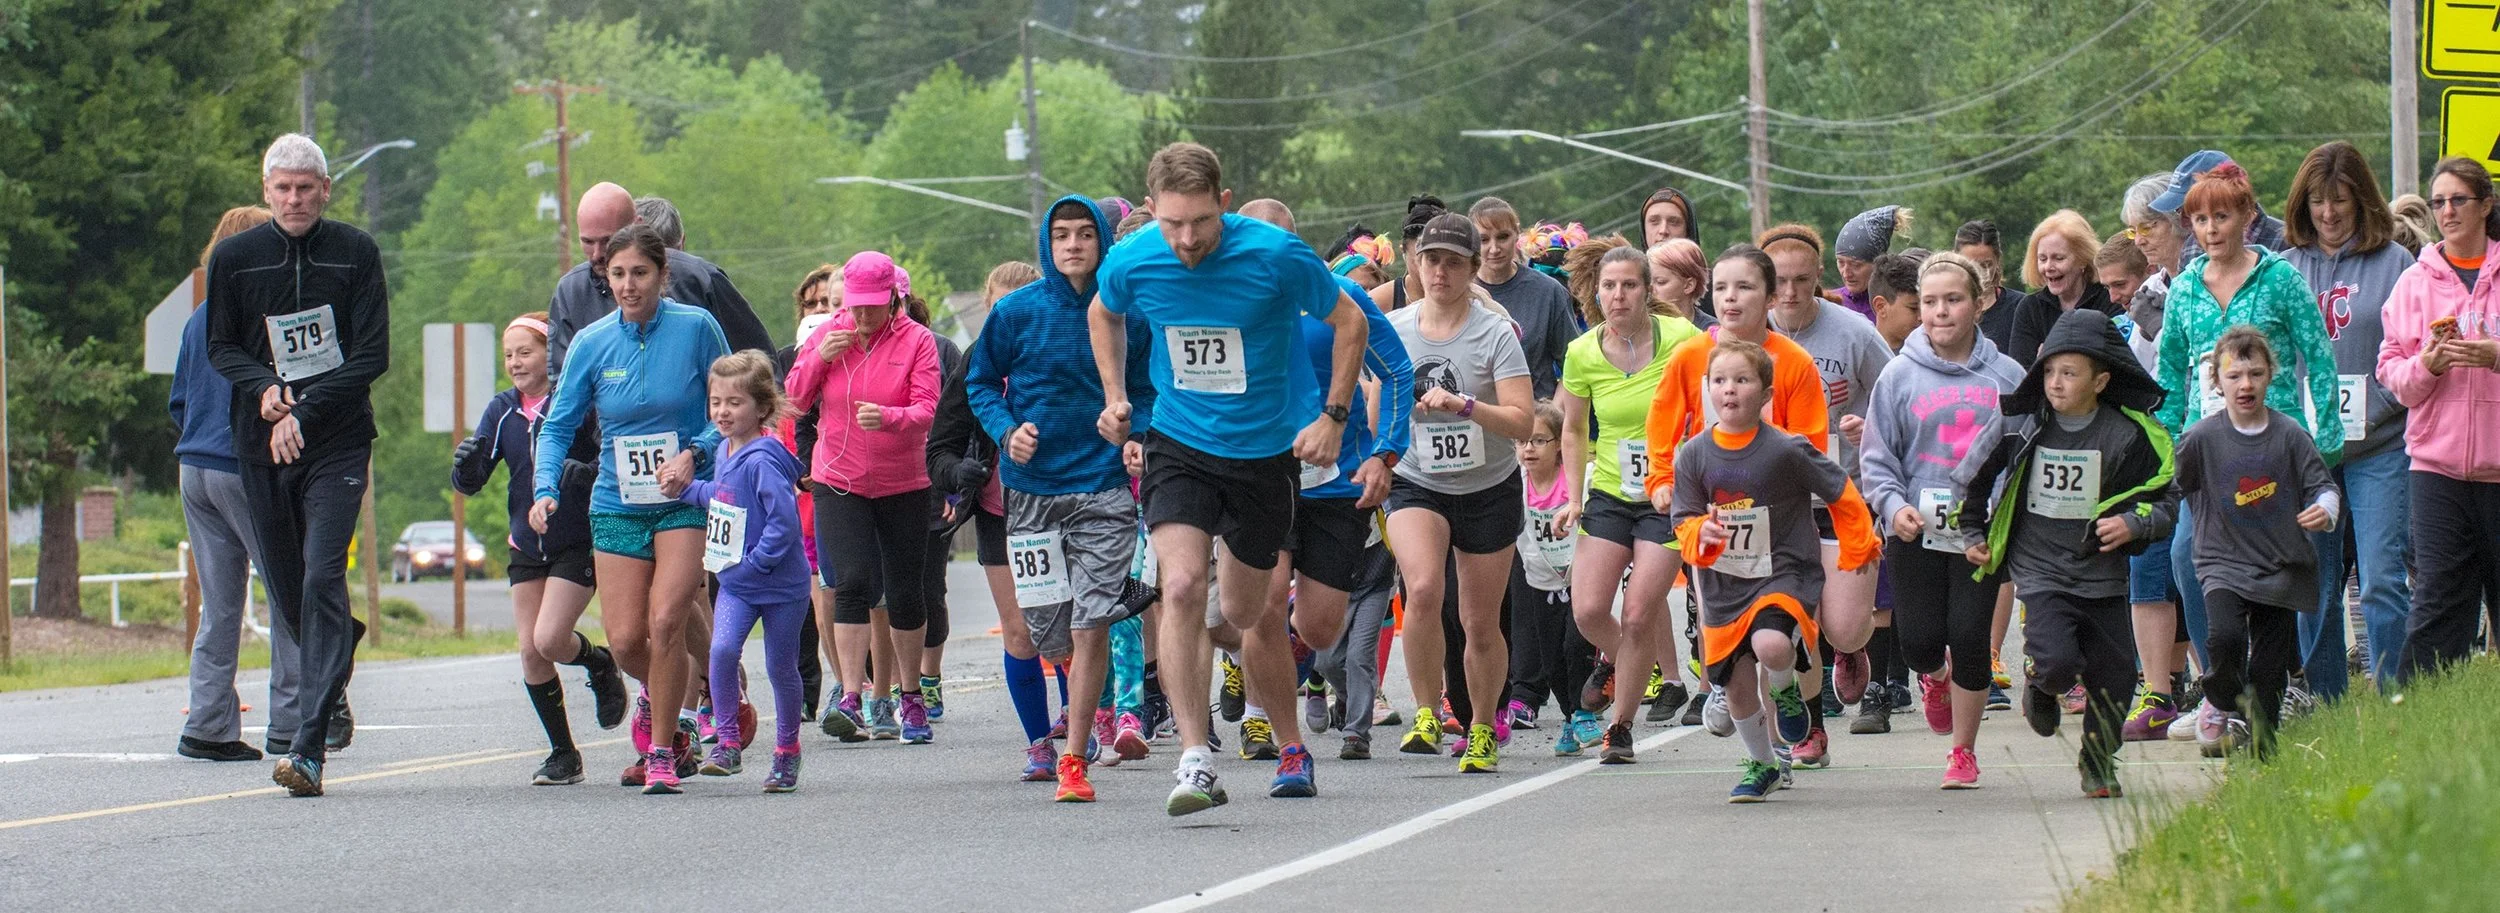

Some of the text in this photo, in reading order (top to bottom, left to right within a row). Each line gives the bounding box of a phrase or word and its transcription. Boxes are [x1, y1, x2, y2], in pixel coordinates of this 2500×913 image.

[277, 313, 321, 327] Team Nanno
[283, 322, 323, 353] 579
[1184, 338, 1226, 366] 573
[1447, 424, 1471, 432] Nanno
[623, 438, 667, 448] Team Nanno
[1432, 433, 1470, 461] 582
[628, 449, 665, 476] 516
[2040, 451, 2088, 462] Team Nanno
[2043, 463, 2083, 491] 532
[1932, 493, 1952, 501] Team
[2246, 486, 2270, 499] MOM
[719, 507, 736, 518] Nanno
[1721, 500, 1746, 510] MOM
[707, 514, 731, 546] 518
[1535, 520, 1563, 543] 54
[1721, 524, 1753, 550] 77
[1010, 538, 1051, 548] Team Nanno
[1014, 548, 1051, 578] 583
